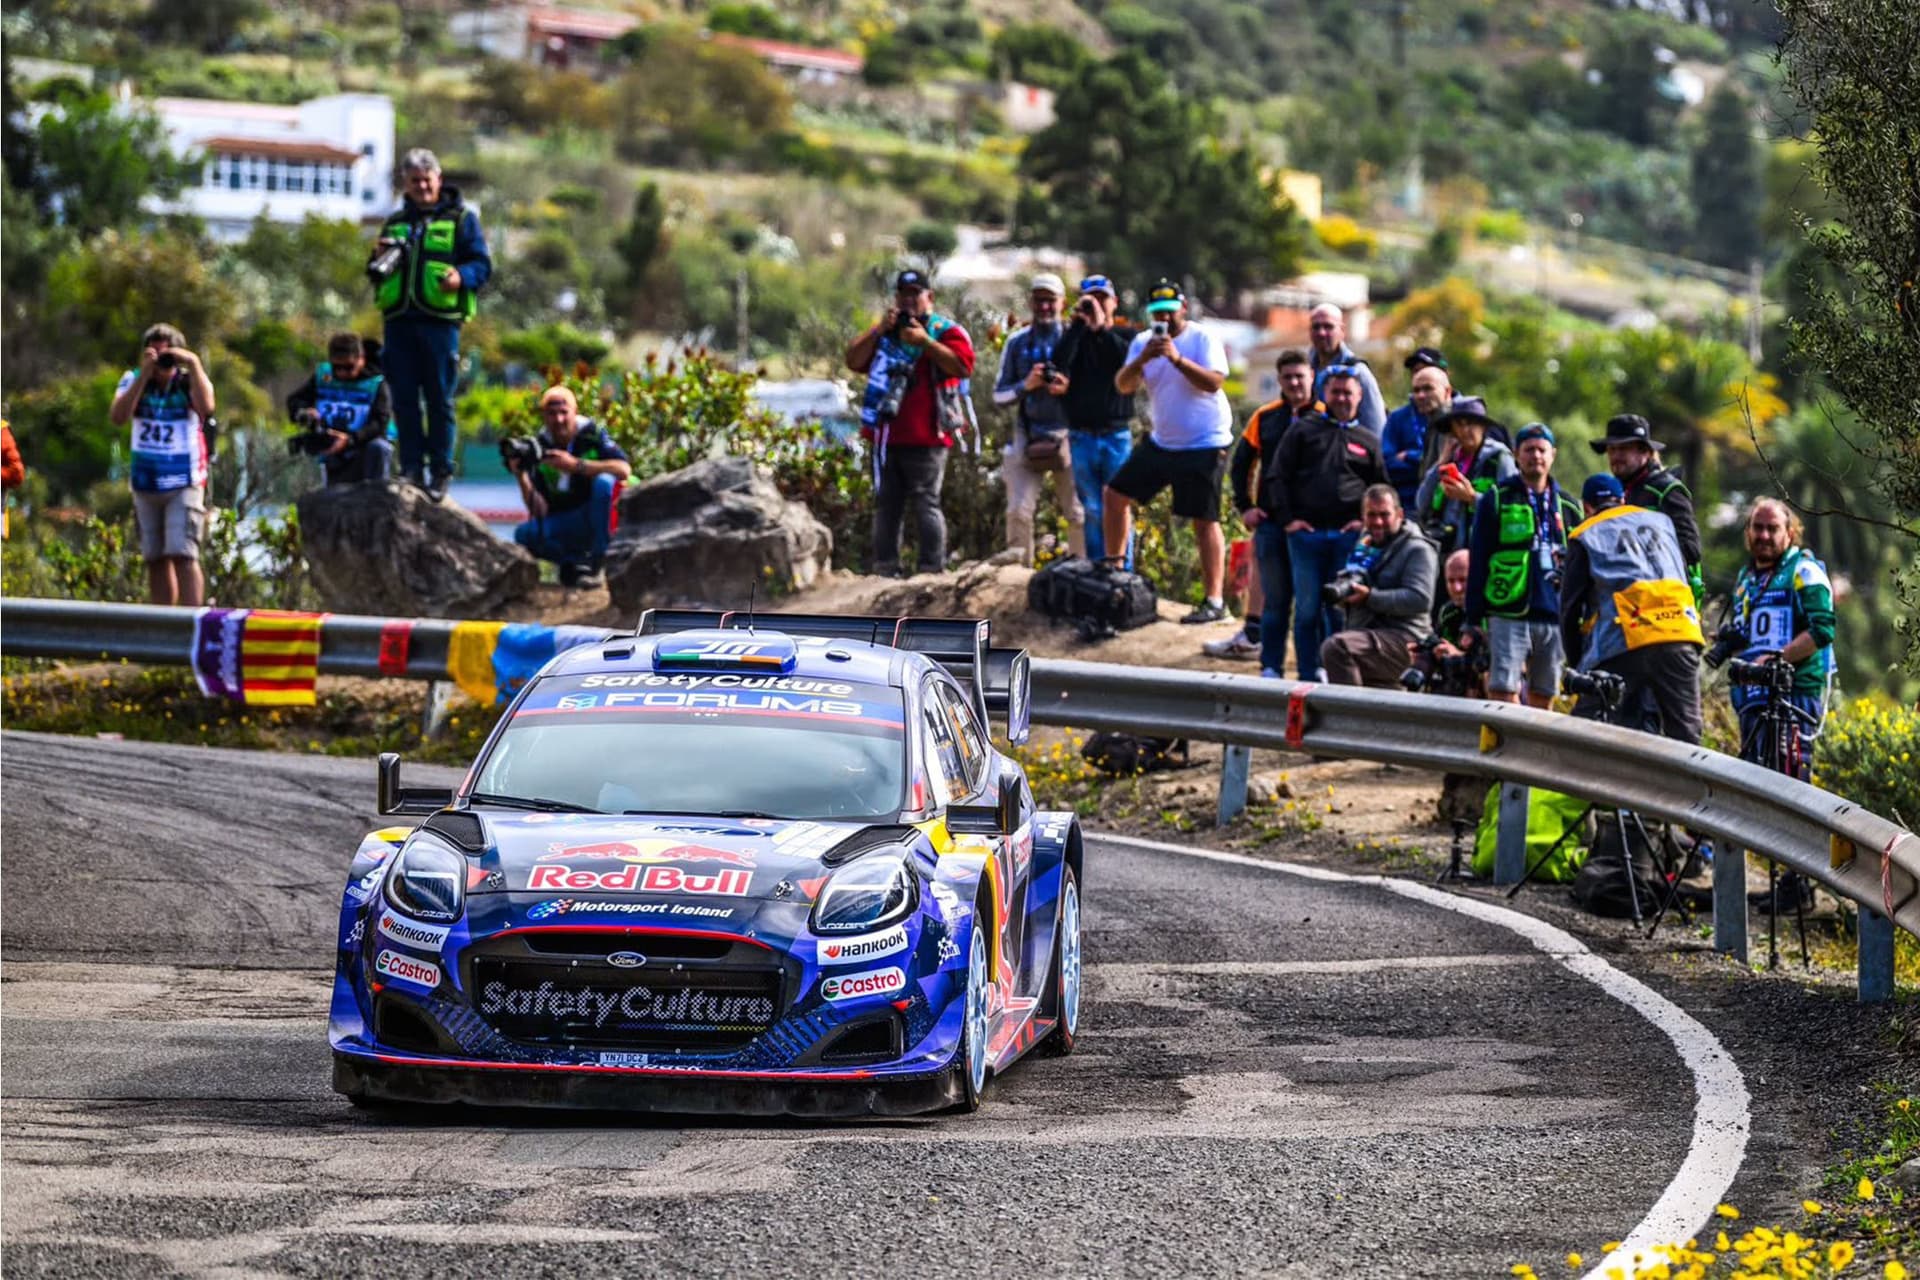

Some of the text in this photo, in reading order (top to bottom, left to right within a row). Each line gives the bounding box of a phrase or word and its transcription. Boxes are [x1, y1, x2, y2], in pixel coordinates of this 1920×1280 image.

[140, 421, 174, 442] 242
[581, 673, 853, 694] SafetyCulture
[604, 693, 863, 716] FORUM8
[526, 865, 754, 896] Red Bull
[570, 902, 733, 918] Motorsport Ireland
[389, 957, 437, 985] Castrol
[614, 955, 638, 965] Ford
[841, 970, 902, 994] Castrol
[481, 981, 774, 1028] SafetyCulture
